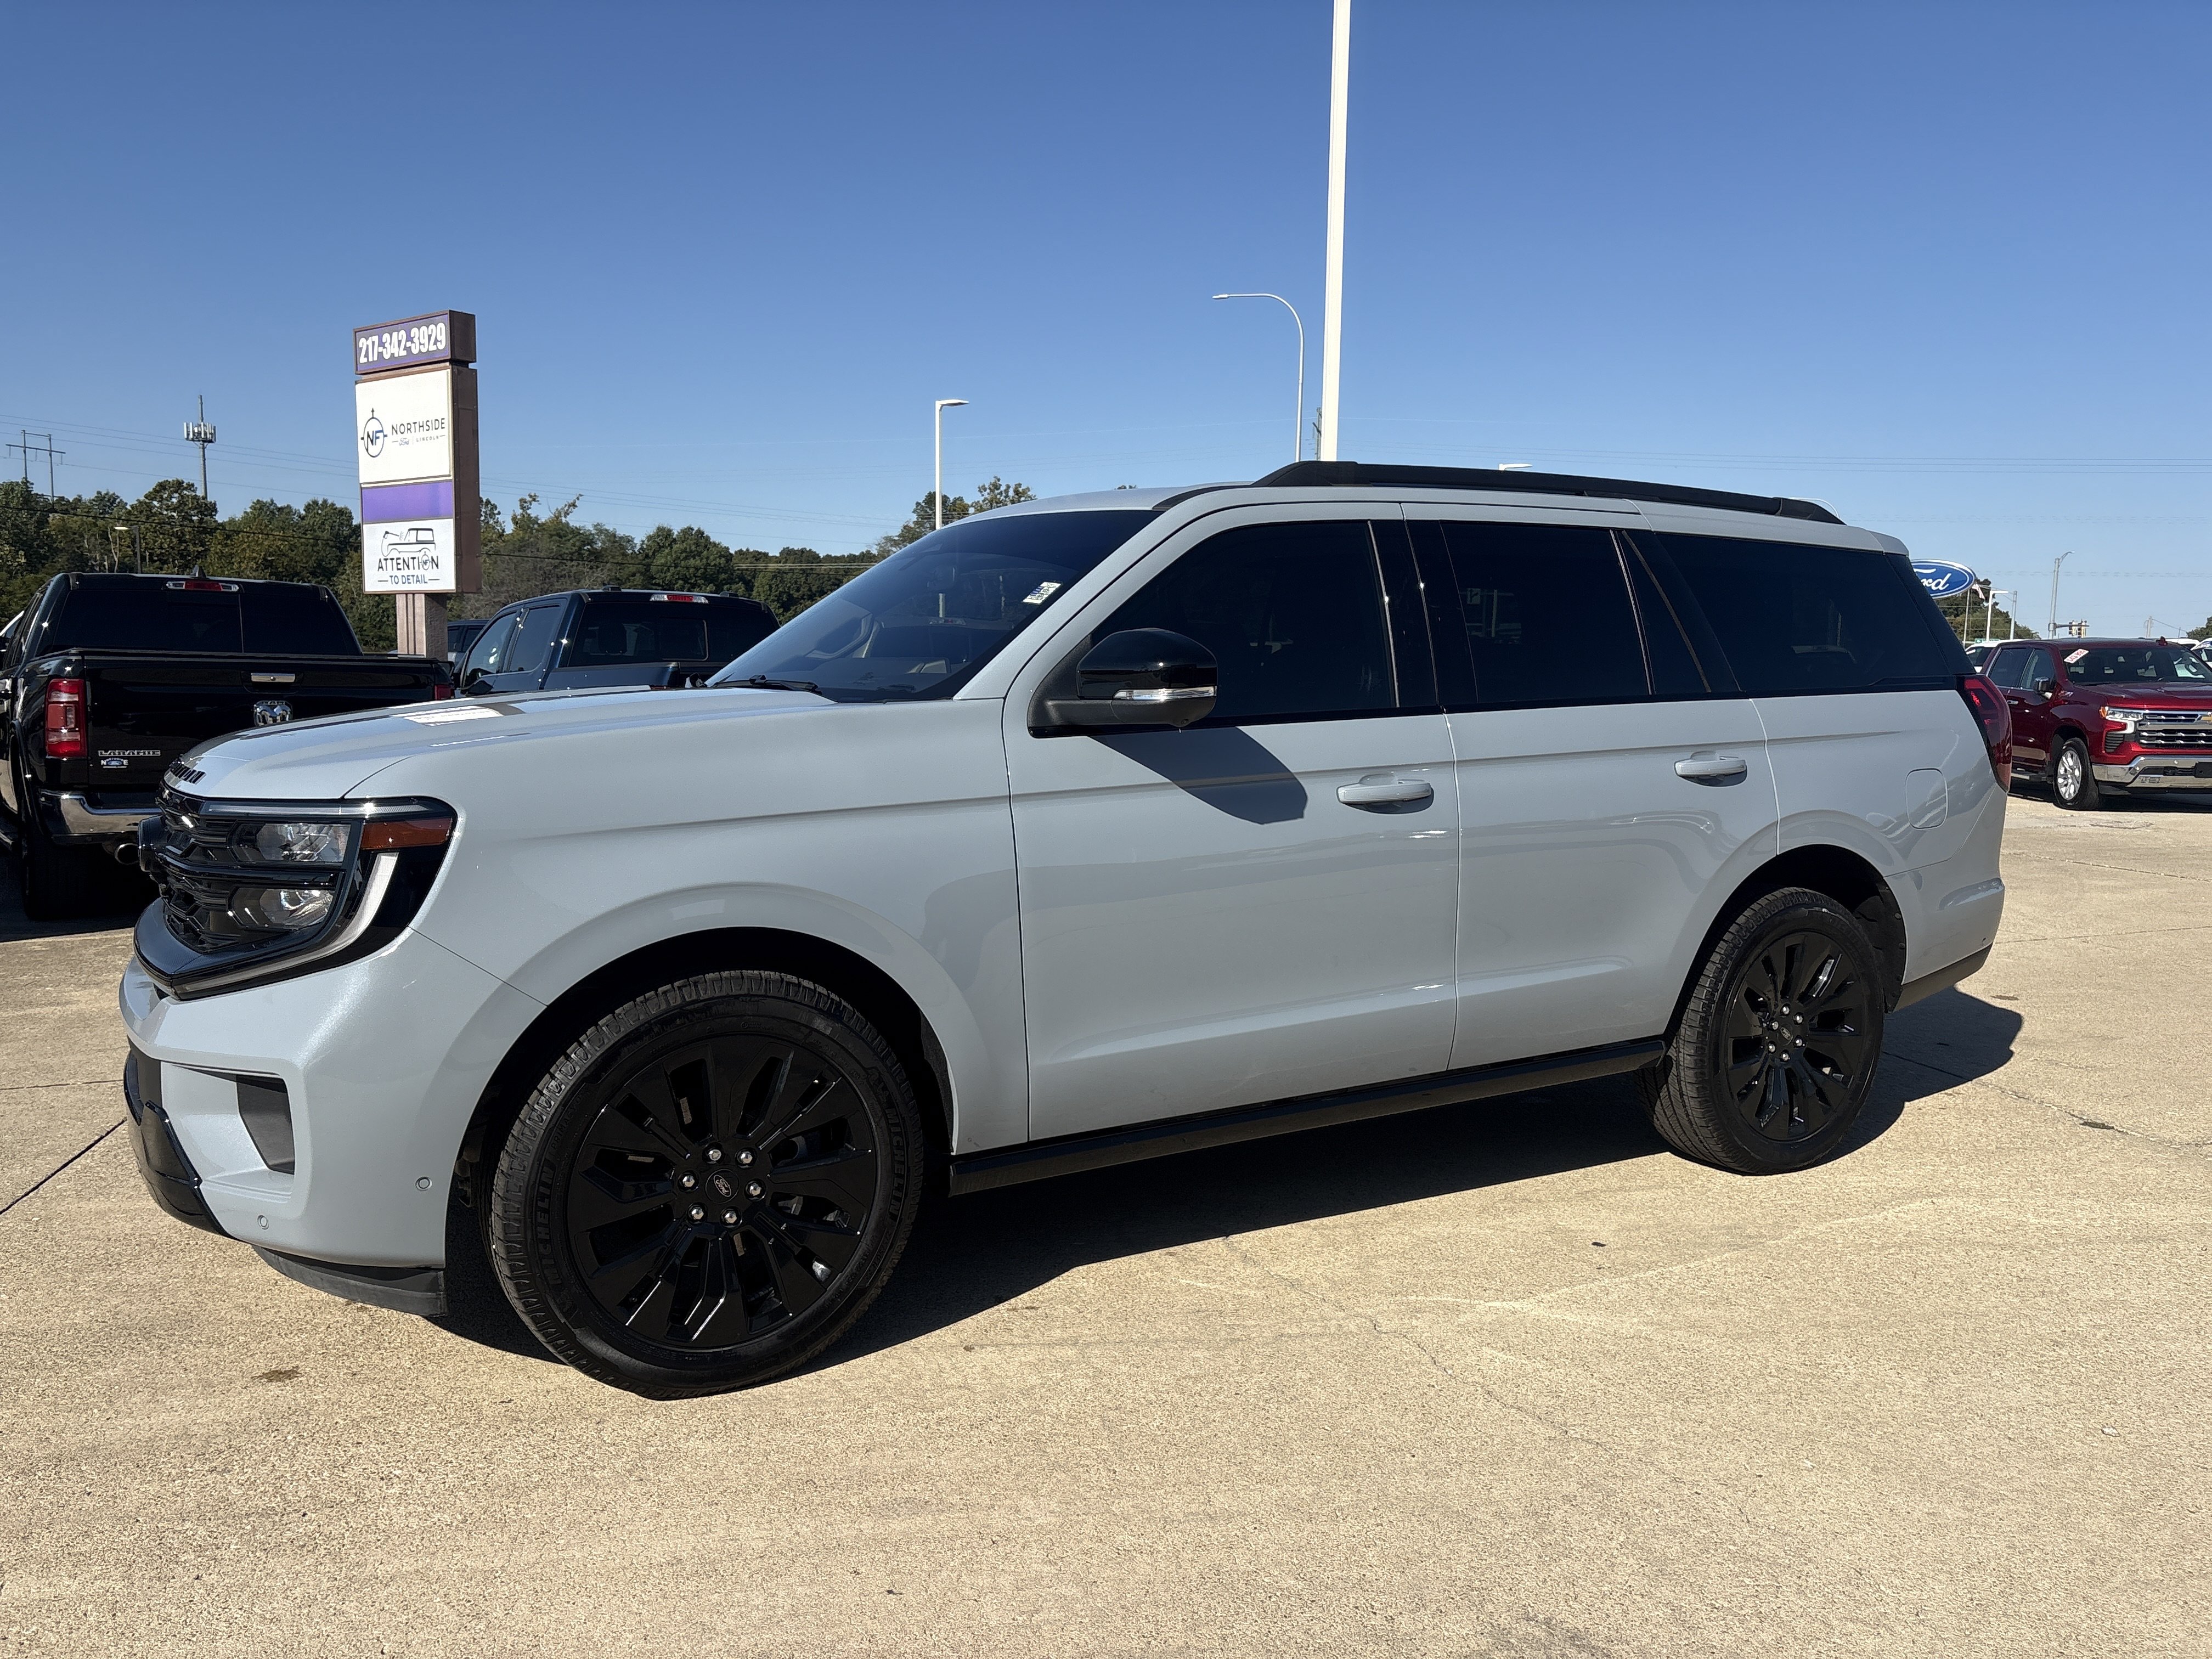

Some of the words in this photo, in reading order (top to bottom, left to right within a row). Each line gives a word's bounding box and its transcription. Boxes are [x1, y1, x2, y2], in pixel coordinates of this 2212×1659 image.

[359, 322, 446, 364] 217-342-3929
[366, 430, 383, 449] NF
[391, 417, 445, 436] NORTHSIDE
[389, 575, 399, 585] TO
[402, 574, 428, 584] DETAIL
[885, 1108, 905, 1216] MICHELIN
[536, 1166, 562, 1285] MICHELIN
